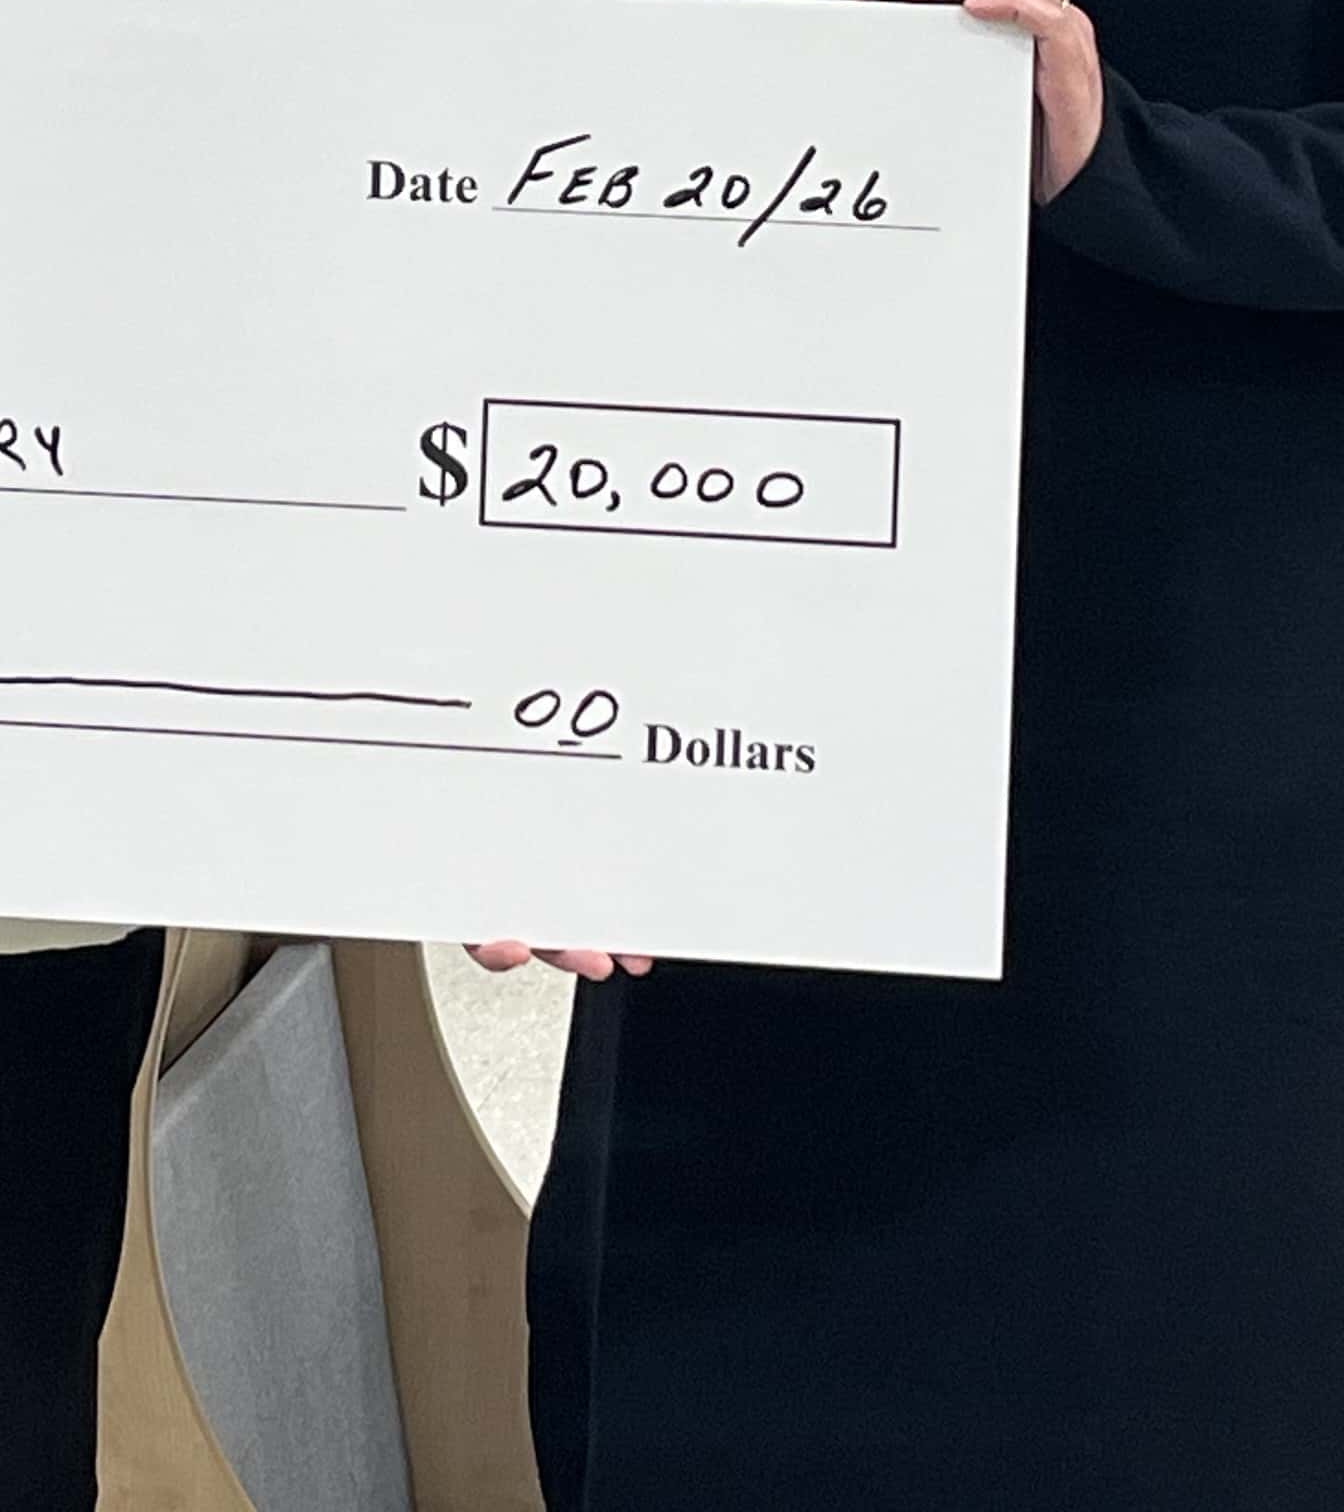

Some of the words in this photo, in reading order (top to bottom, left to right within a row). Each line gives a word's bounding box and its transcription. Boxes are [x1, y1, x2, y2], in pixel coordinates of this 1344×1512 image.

[365, 158, 480, 205] Date
[505, 133, 640, 209] FEB
[662, 145, 888, 248] 20/26
[501, 444, 806, 512] 20,000
[512, 687, 621, 739] 00
[641, 722, 819, 777] Dollars
